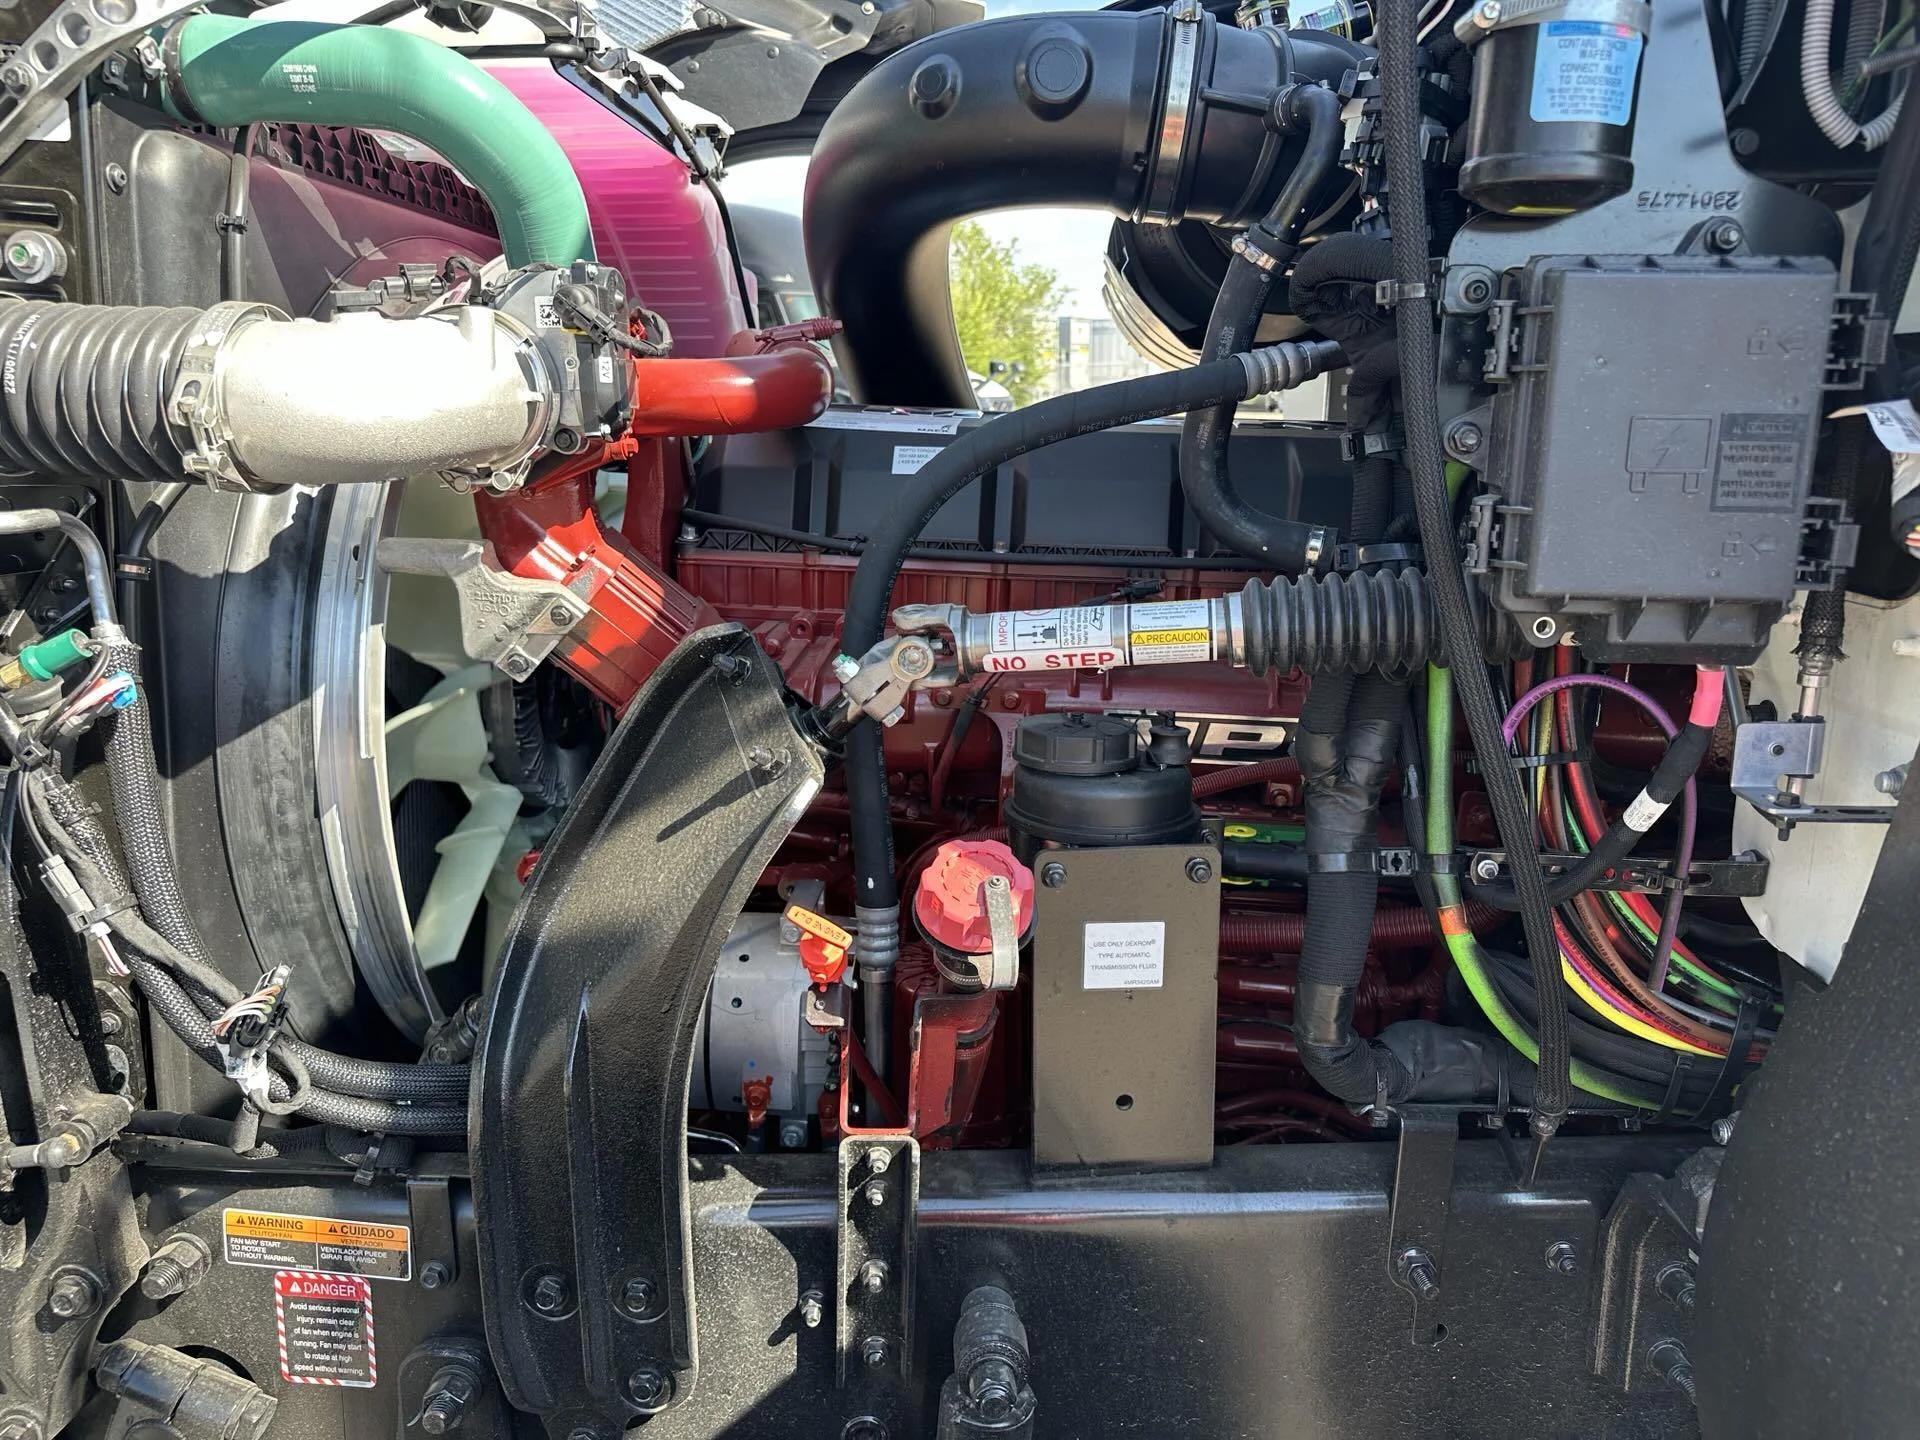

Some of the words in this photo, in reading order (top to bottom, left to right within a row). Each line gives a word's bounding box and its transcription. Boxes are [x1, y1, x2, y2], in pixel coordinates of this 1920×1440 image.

[1580, 50, 1612, 60] WAFER
[1560, 64, 1599, 73] CONNECT
[1560, 75, 1571, 84] TO
[12, 314, 40, 341] CHINA
[602, 360, 610, 379] 12V
[1146, 631, 1207, 644] PRECAUCIÓN
[992, 656, 1026, 671] NO
[1045, 652, 1115, 668] STEP
[248, 1216, 304, 1231] WARNING
[250, 1229, 276, 1238] CLUTCH
[277, 1231, 293, 1240] FAN
[340, 1225, 395, 1239] CUIDADO
[230, 1237, 244, 1245] FAN
[245, 1238, 259, 1246] MAY
[260, 1240, 281, 1248] START
[340, 1238, 384, 1248] VENTILADOR
[242, 1245, 267, 1254] ROTATE
[320, 1246, 363, 1256] VENTILADOR
[364, 1250, 387, 1258] PUEDE
[230, 1250, 263, 1260] WITHOUT
[263, 1253, 297, 1263] WARNING.
[320, 1252, 342, 1260] GIRAR
[343, 1254, 355, 1262] SIN
[304, 1281, 356, 1297] DANGER
[290, 1301, 307, 1311] Avoid
[308, 1304, 331, 1312] serious
[332, 1306, 360, 1314] personal
[316, 1317, 338, 1326] remain
[339, 1318, 355, 1326] clear
[302, 1327, 312, 1335] fan
[313, 1329, 330, 1337] when
[331, 1330, 353, 1339] engine
[333, 1343, 347, 1351] may
[347, 1343, 362, 1351] start
[304, 1351, 311, 1359] to
[338, 1354, 353, 1363] high
[294, 1364, 314, 1372] speed
[314, 1364, 338, 1373] without
[338, 1367, 365, 1376] warning.
